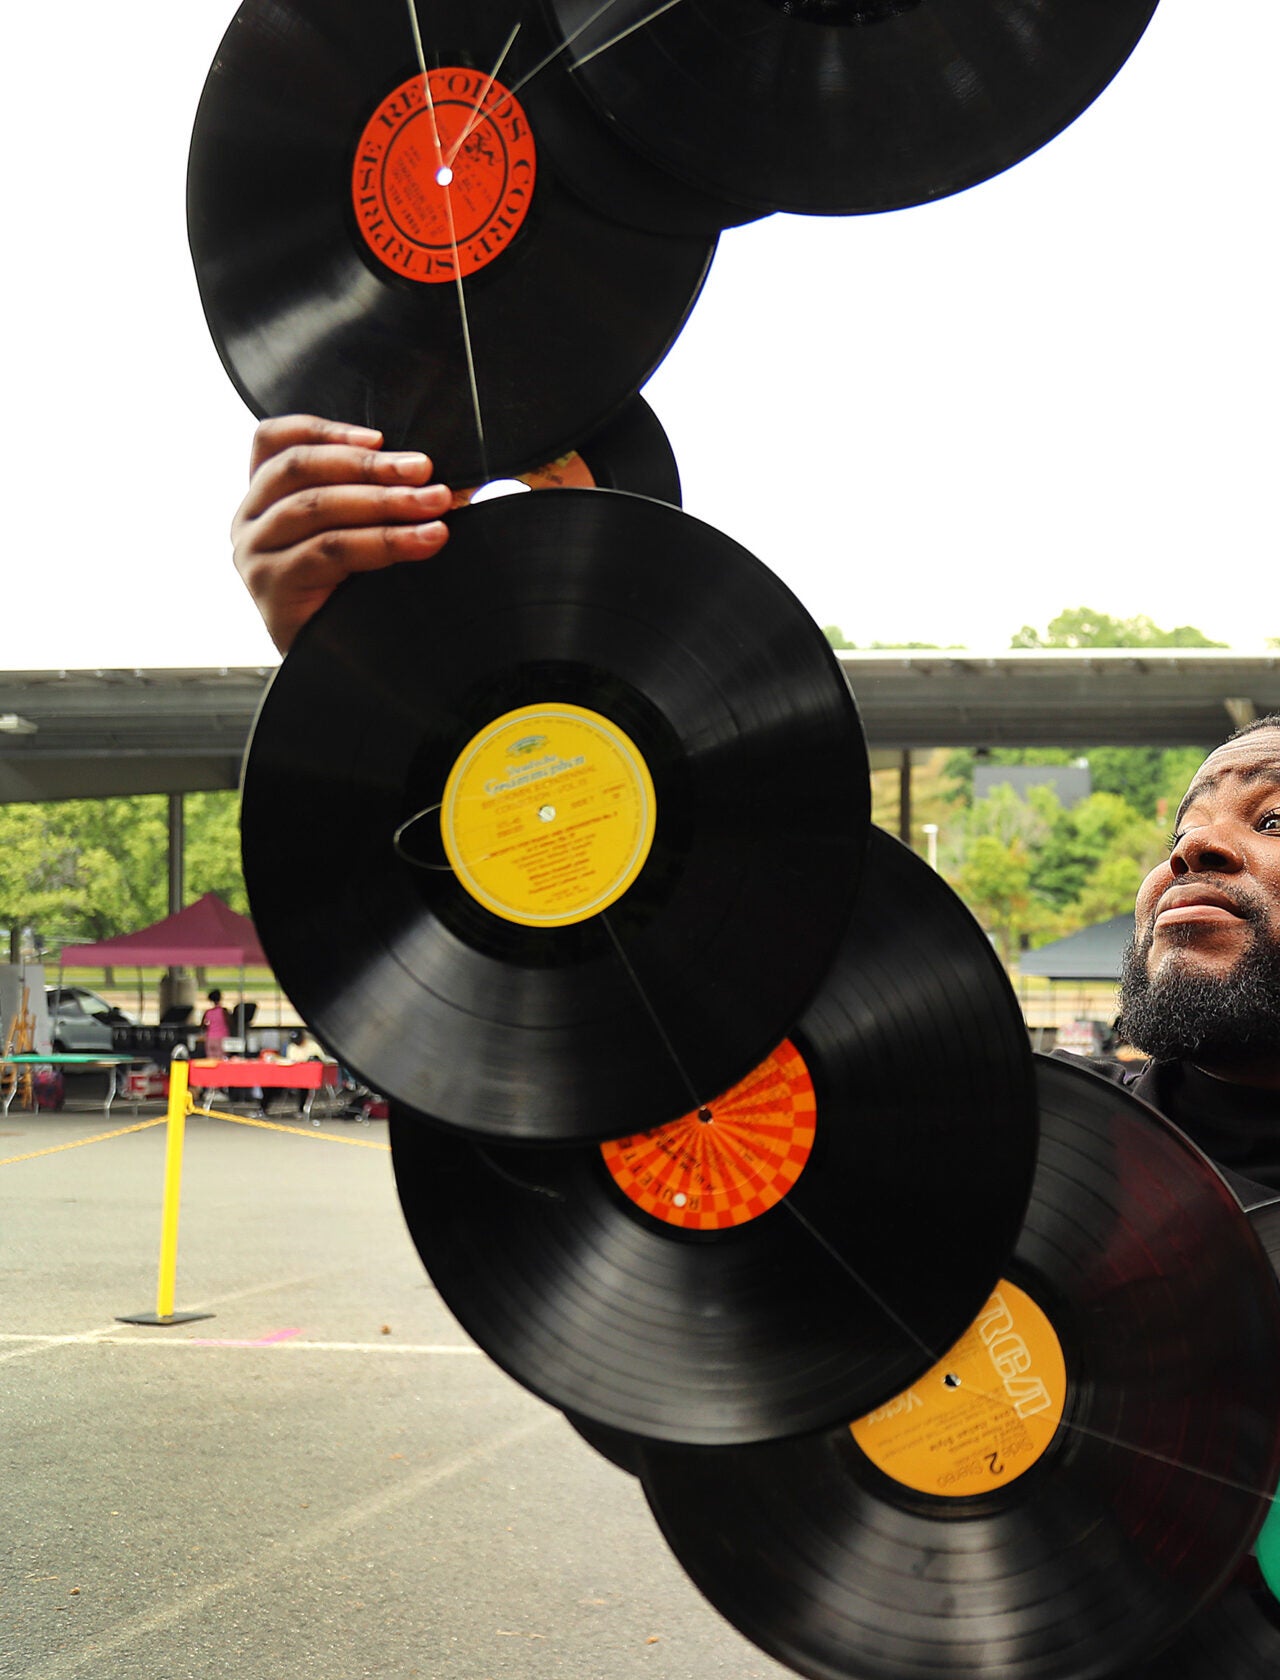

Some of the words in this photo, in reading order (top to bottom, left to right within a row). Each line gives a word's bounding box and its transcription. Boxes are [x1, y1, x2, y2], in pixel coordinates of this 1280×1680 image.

[377, 72, 528, 143] RECORDS
[359, 140, 455, 276] SURPRISE
[617, 1136, 701, 1211] RULETTE
[976, 1292, 1052, 1420] RCA
[985, 1452, 1004, 1475] 2
